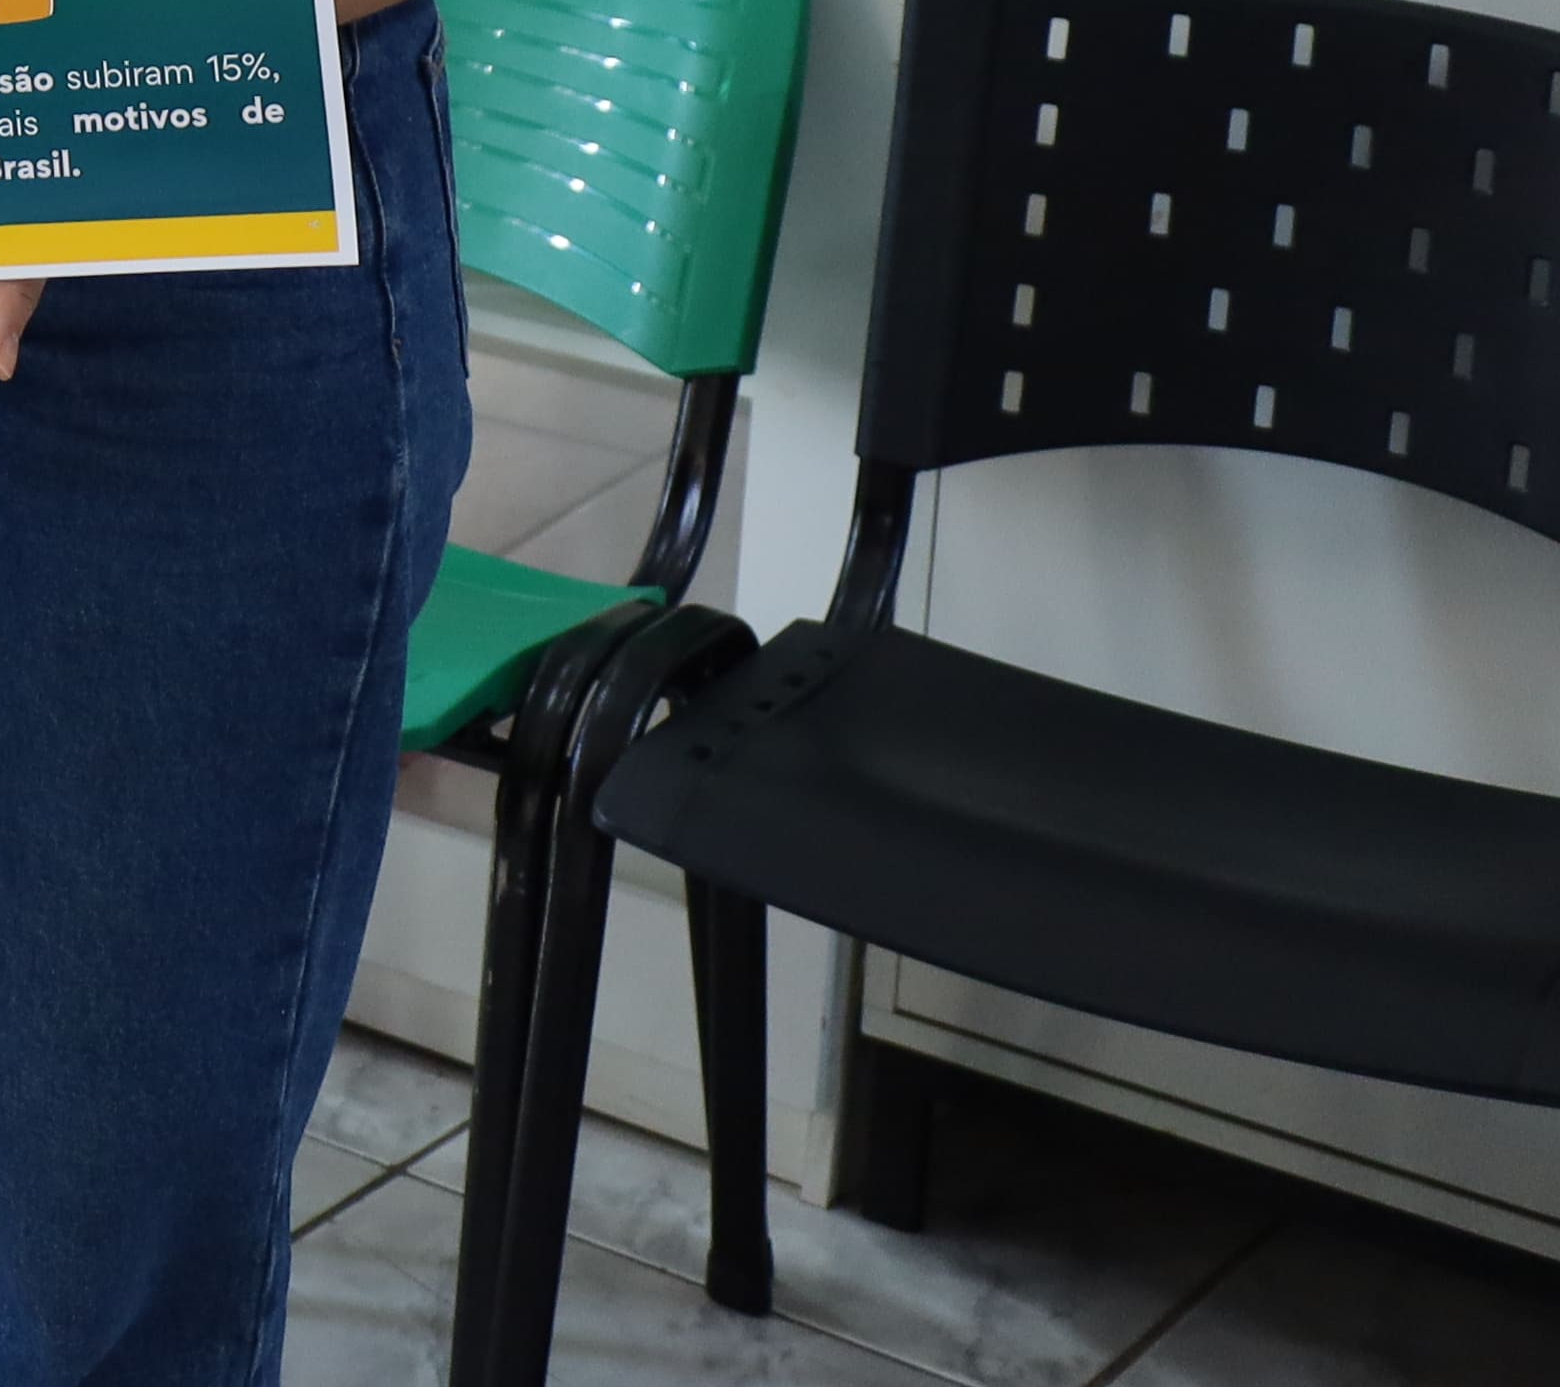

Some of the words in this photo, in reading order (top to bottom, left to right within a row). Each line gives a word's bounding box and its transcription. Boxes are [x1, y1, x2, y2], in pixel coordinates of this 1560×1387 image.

[66, 59, 194, 91] subiram
[206, 52, 280, 84] 15%,
[73, 101, 208, 134] motivos
[241, 95, 285, 125] de
